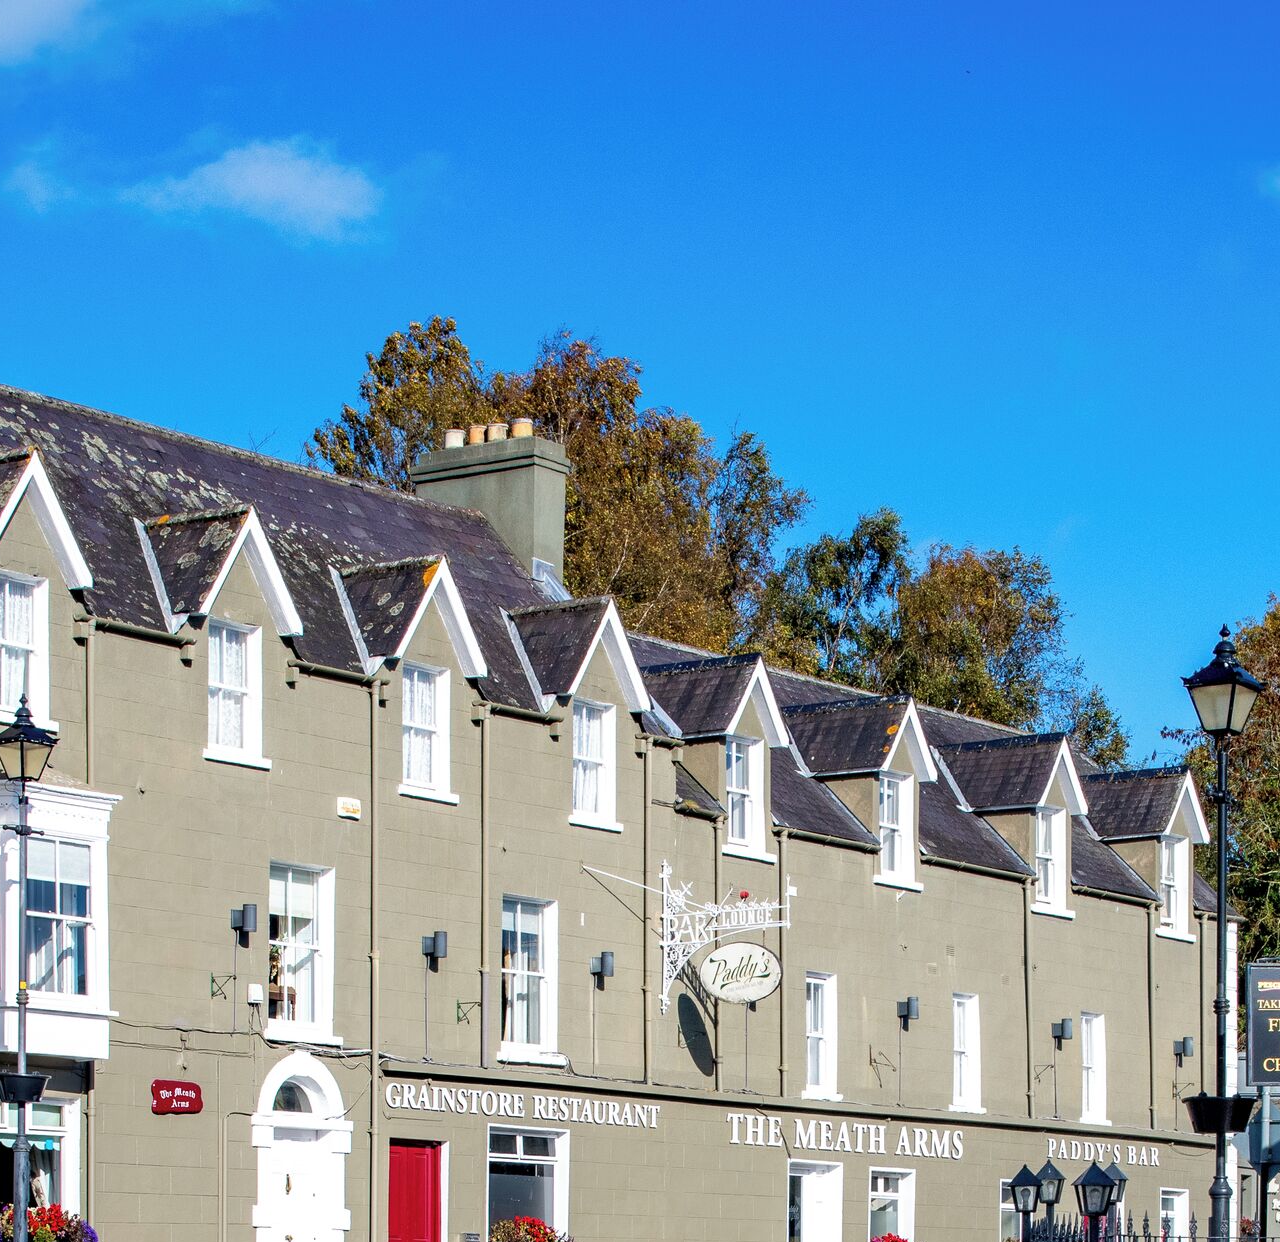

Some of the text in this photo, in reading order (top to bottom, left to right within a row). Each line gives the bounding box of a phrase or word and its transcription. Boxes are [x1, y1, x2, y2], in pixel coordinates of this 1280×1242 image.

[722, 909, 773, 926] LOUNGE
[710, 952, 771, 987] Paddy's
[385, 1082, 660, 1128] GRAINSTORE RESTAURANT
[726, 1113, 964, 1159] THE MEATH ARMS
[1047, 1138, 1160, 1166] PADDY'S BAR
